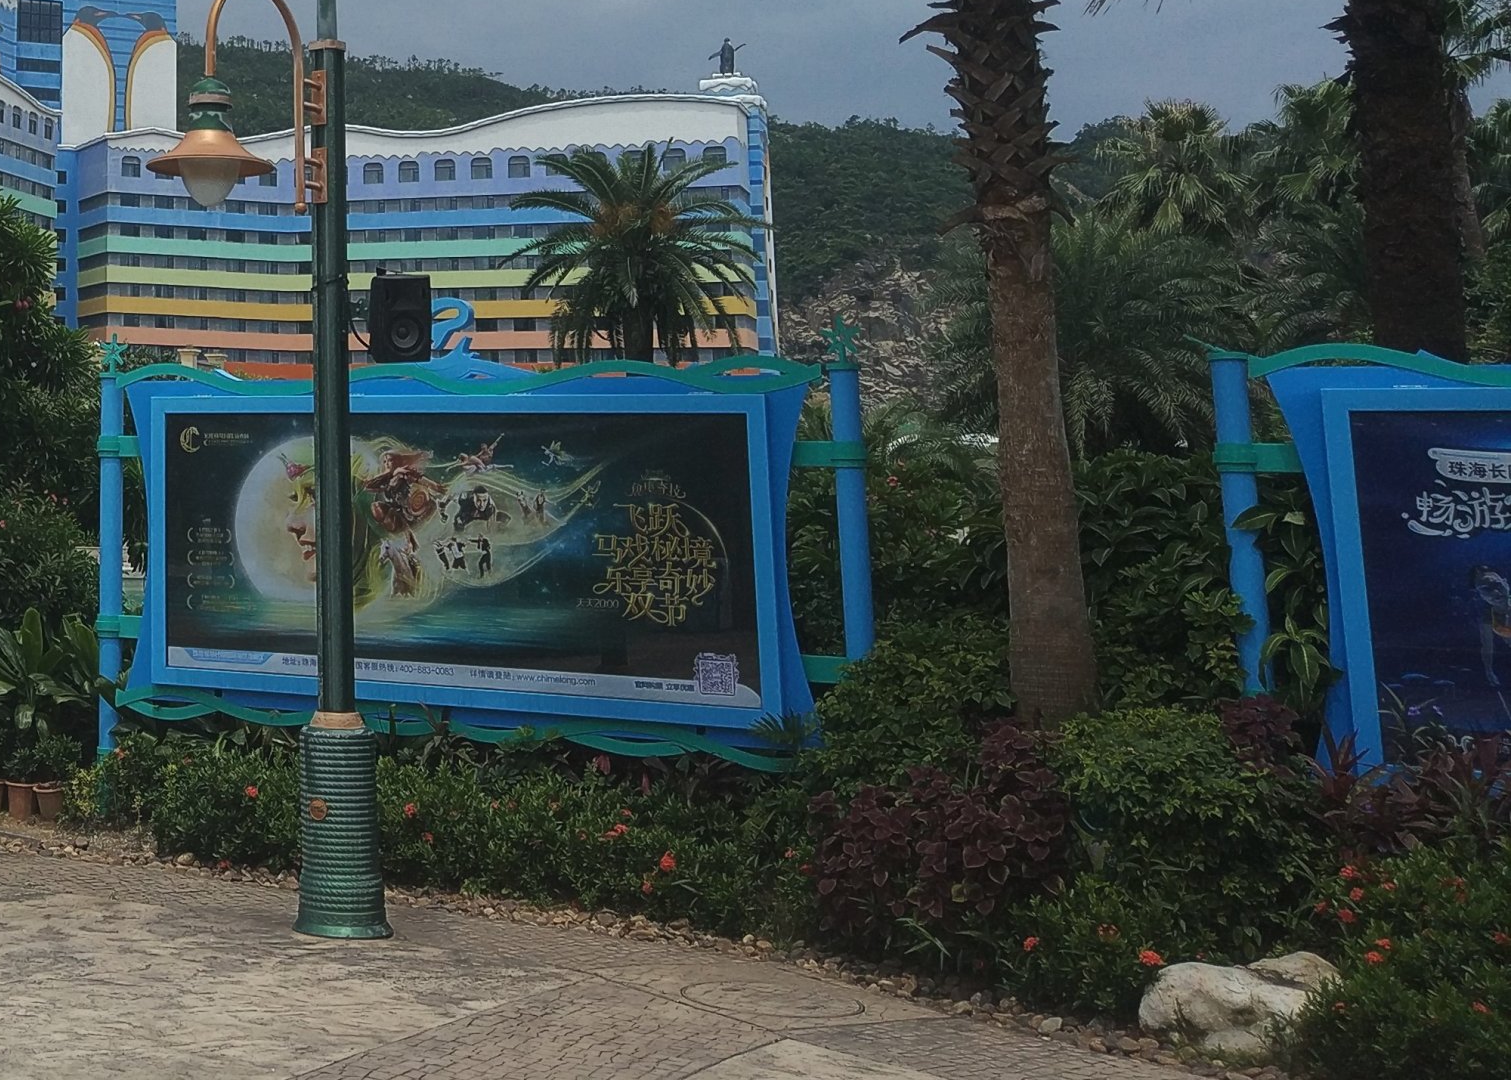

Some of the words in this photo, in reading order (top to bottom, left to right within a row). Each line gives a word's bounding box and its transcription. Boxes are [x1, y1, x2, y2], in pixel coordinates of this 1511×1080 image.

[1448, 461, 1511, 479] 珠海长
[613, 502, 690, 537] 飞跃
[1416, 486, 1511, 533] 畅游
[592, 532, 717, 569] 马戏秘境
[592, 562, 716, 605] 乐享奇妙
[621, 593, 688, 627] 双节
